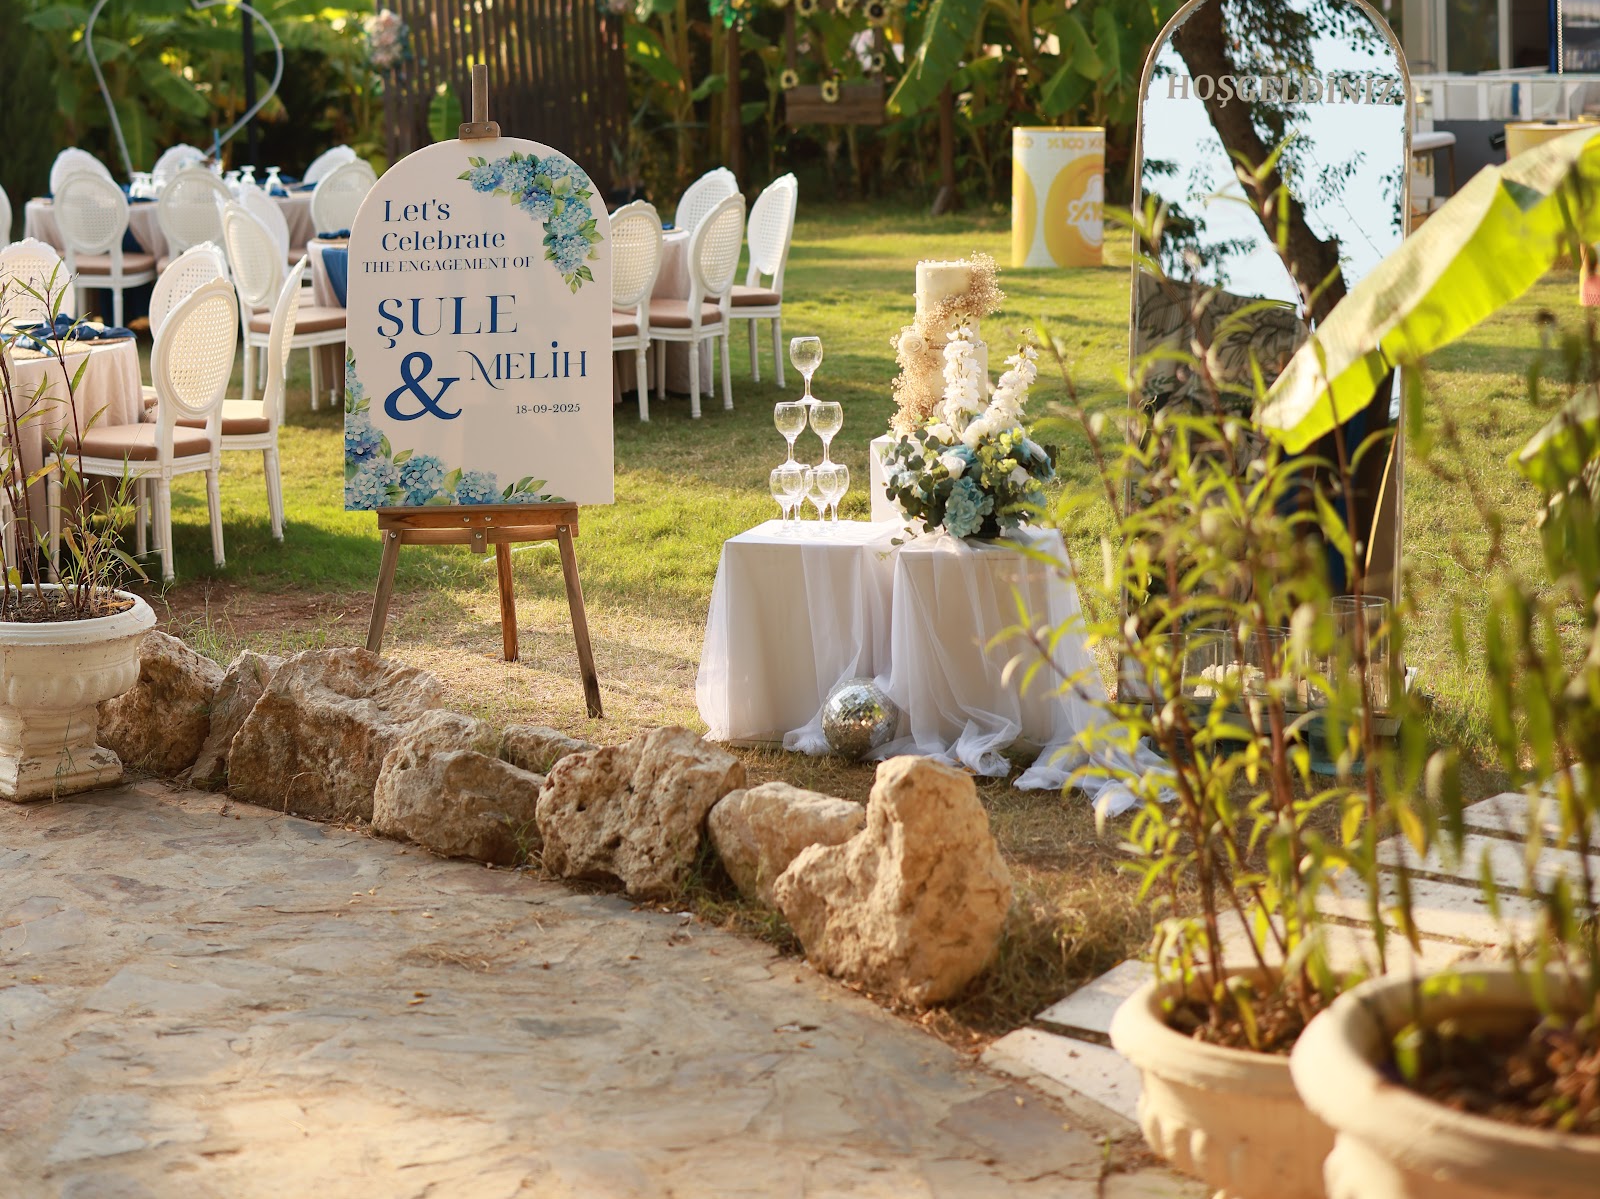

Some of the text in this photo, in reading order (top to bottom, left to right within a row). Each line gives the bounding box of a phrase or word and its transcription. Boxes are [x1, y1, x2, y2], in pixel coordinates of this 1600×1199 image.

[1167, 72, 1396, 108] HOŞGELDİNİZ
[383, 199, 451, 222] Let's
[381, 231, 505, 251] Celebrate
[362, 256, 534, 273] THE ENGAGEMENT OF
[377, 295, 517, 349] ŞULE
[383, 351, 463, 421] &
[515, 403, 581, 415] 18-09-2025
